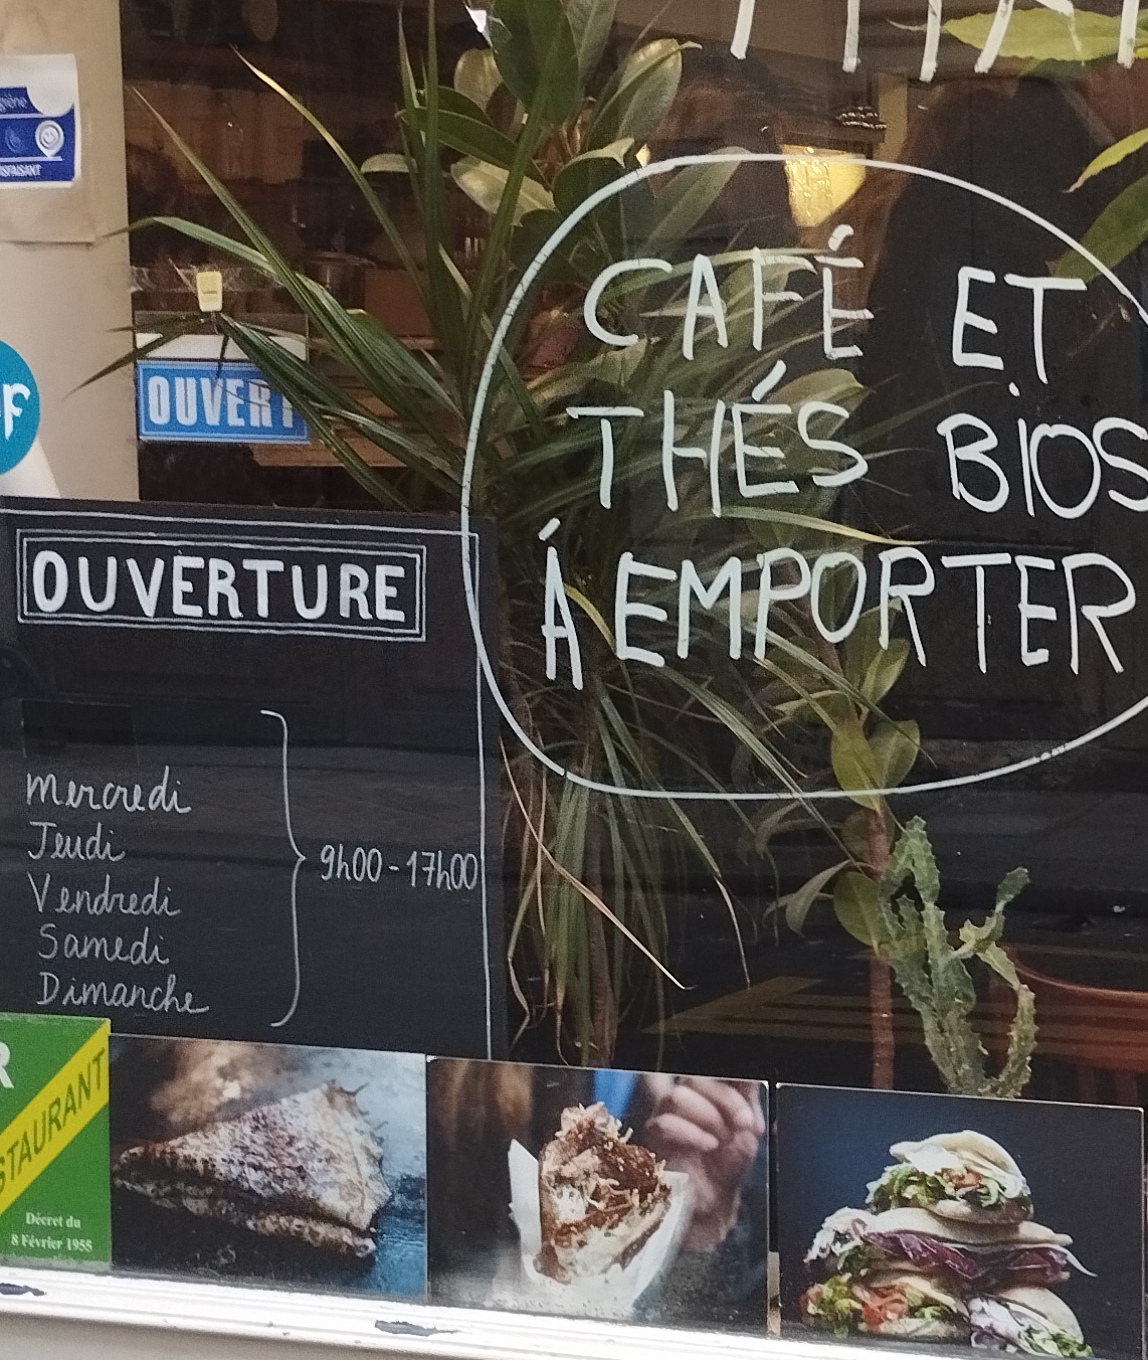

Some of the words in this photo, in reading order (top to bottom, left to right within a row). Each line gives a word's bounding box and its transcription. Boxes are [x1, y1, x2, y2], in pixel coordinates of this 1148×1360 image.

[583, 225, 875, 361] CAFÉ
[950, 266, 1088, 385] ET
[566, 360, 869, 518] THÉS
[31, 548, 407, 623] OUVERTURE
[613, 546, 1137, 675] EMPORTER
[26, 821, 126, 863] Jeudi
[26, 870, 182, 917] Vendredi
[37, 923, 170, 966] Samedi
[36, 971, 210, 1014] Dimanche
[25, 1211, 64, 1228] Décret
[65, 1216, 82, 1229] du
[21, 1233, 63, 1251] Février
[65, 1237, 93, 1253] 1955
